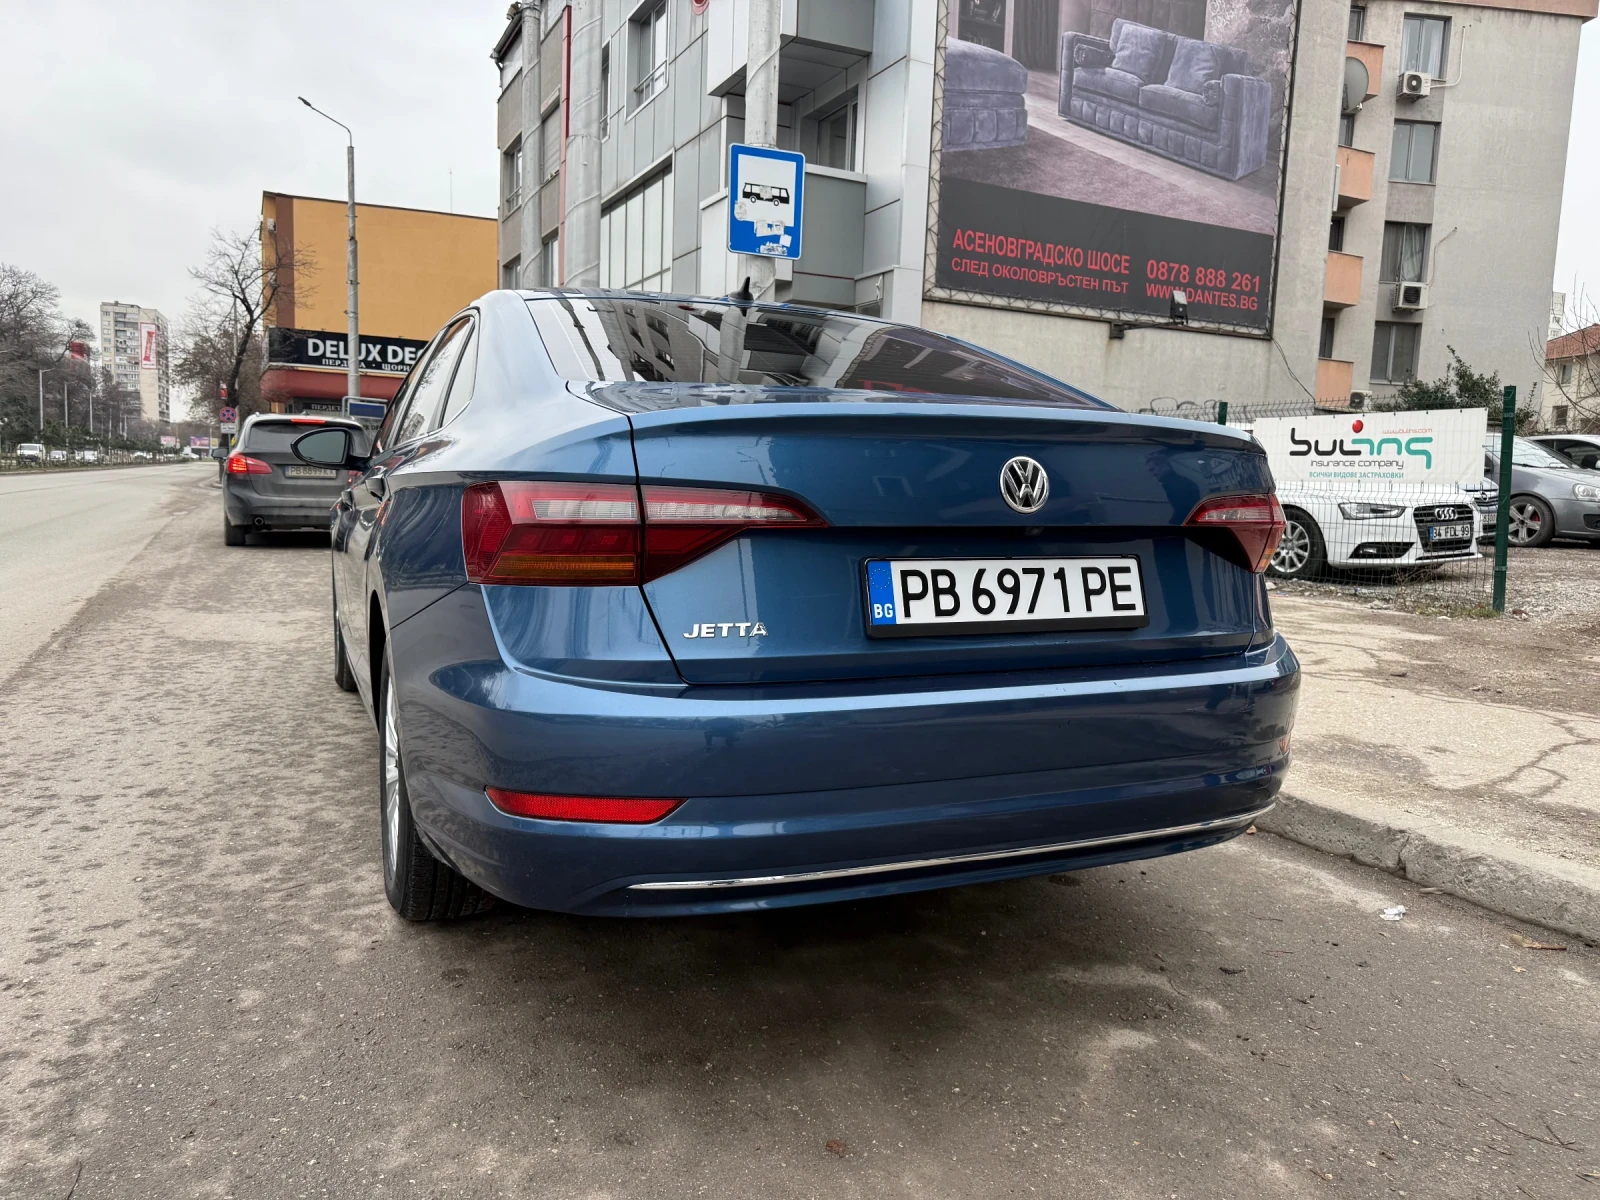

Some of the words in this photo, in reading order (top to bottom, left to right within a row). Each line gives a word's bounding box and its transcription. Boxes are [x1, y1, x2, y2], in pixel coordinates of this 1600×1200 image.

[952, 228, 1084, 268] АСЕНОВГРАДСКО
[1087, 249, 1131, 275] ШОСЕ
[951, 257, 989, 278] СЛЕД
[992, 263, 1099, 290] ОКОЛОВРЪСТЕН
[1102, 279, 1129, 294] ПЪТ
[1146, 259, 1190, 284] 0878
[1195, 266, 1227, 288] 888
[1231, 272, 1260, 293] 261
[1308, 471, 1333, 479] ВСИЧКИ
[1333, 471, 1358, 479] ВИДОВЕ
[1359, 471, 1404, 479] ЗАСТРАХОВКИ
[1310, 459, 1356, 468] insurance
[1357, 459, 1405, 470] company
[899, 569, 961, 619] PB
[971, 567, 1071, 616] 6971
[1081, 565, 1137, 613] PE
[873, 603, 893, 618] BG
[683, 622, 768, 638] JETTA
